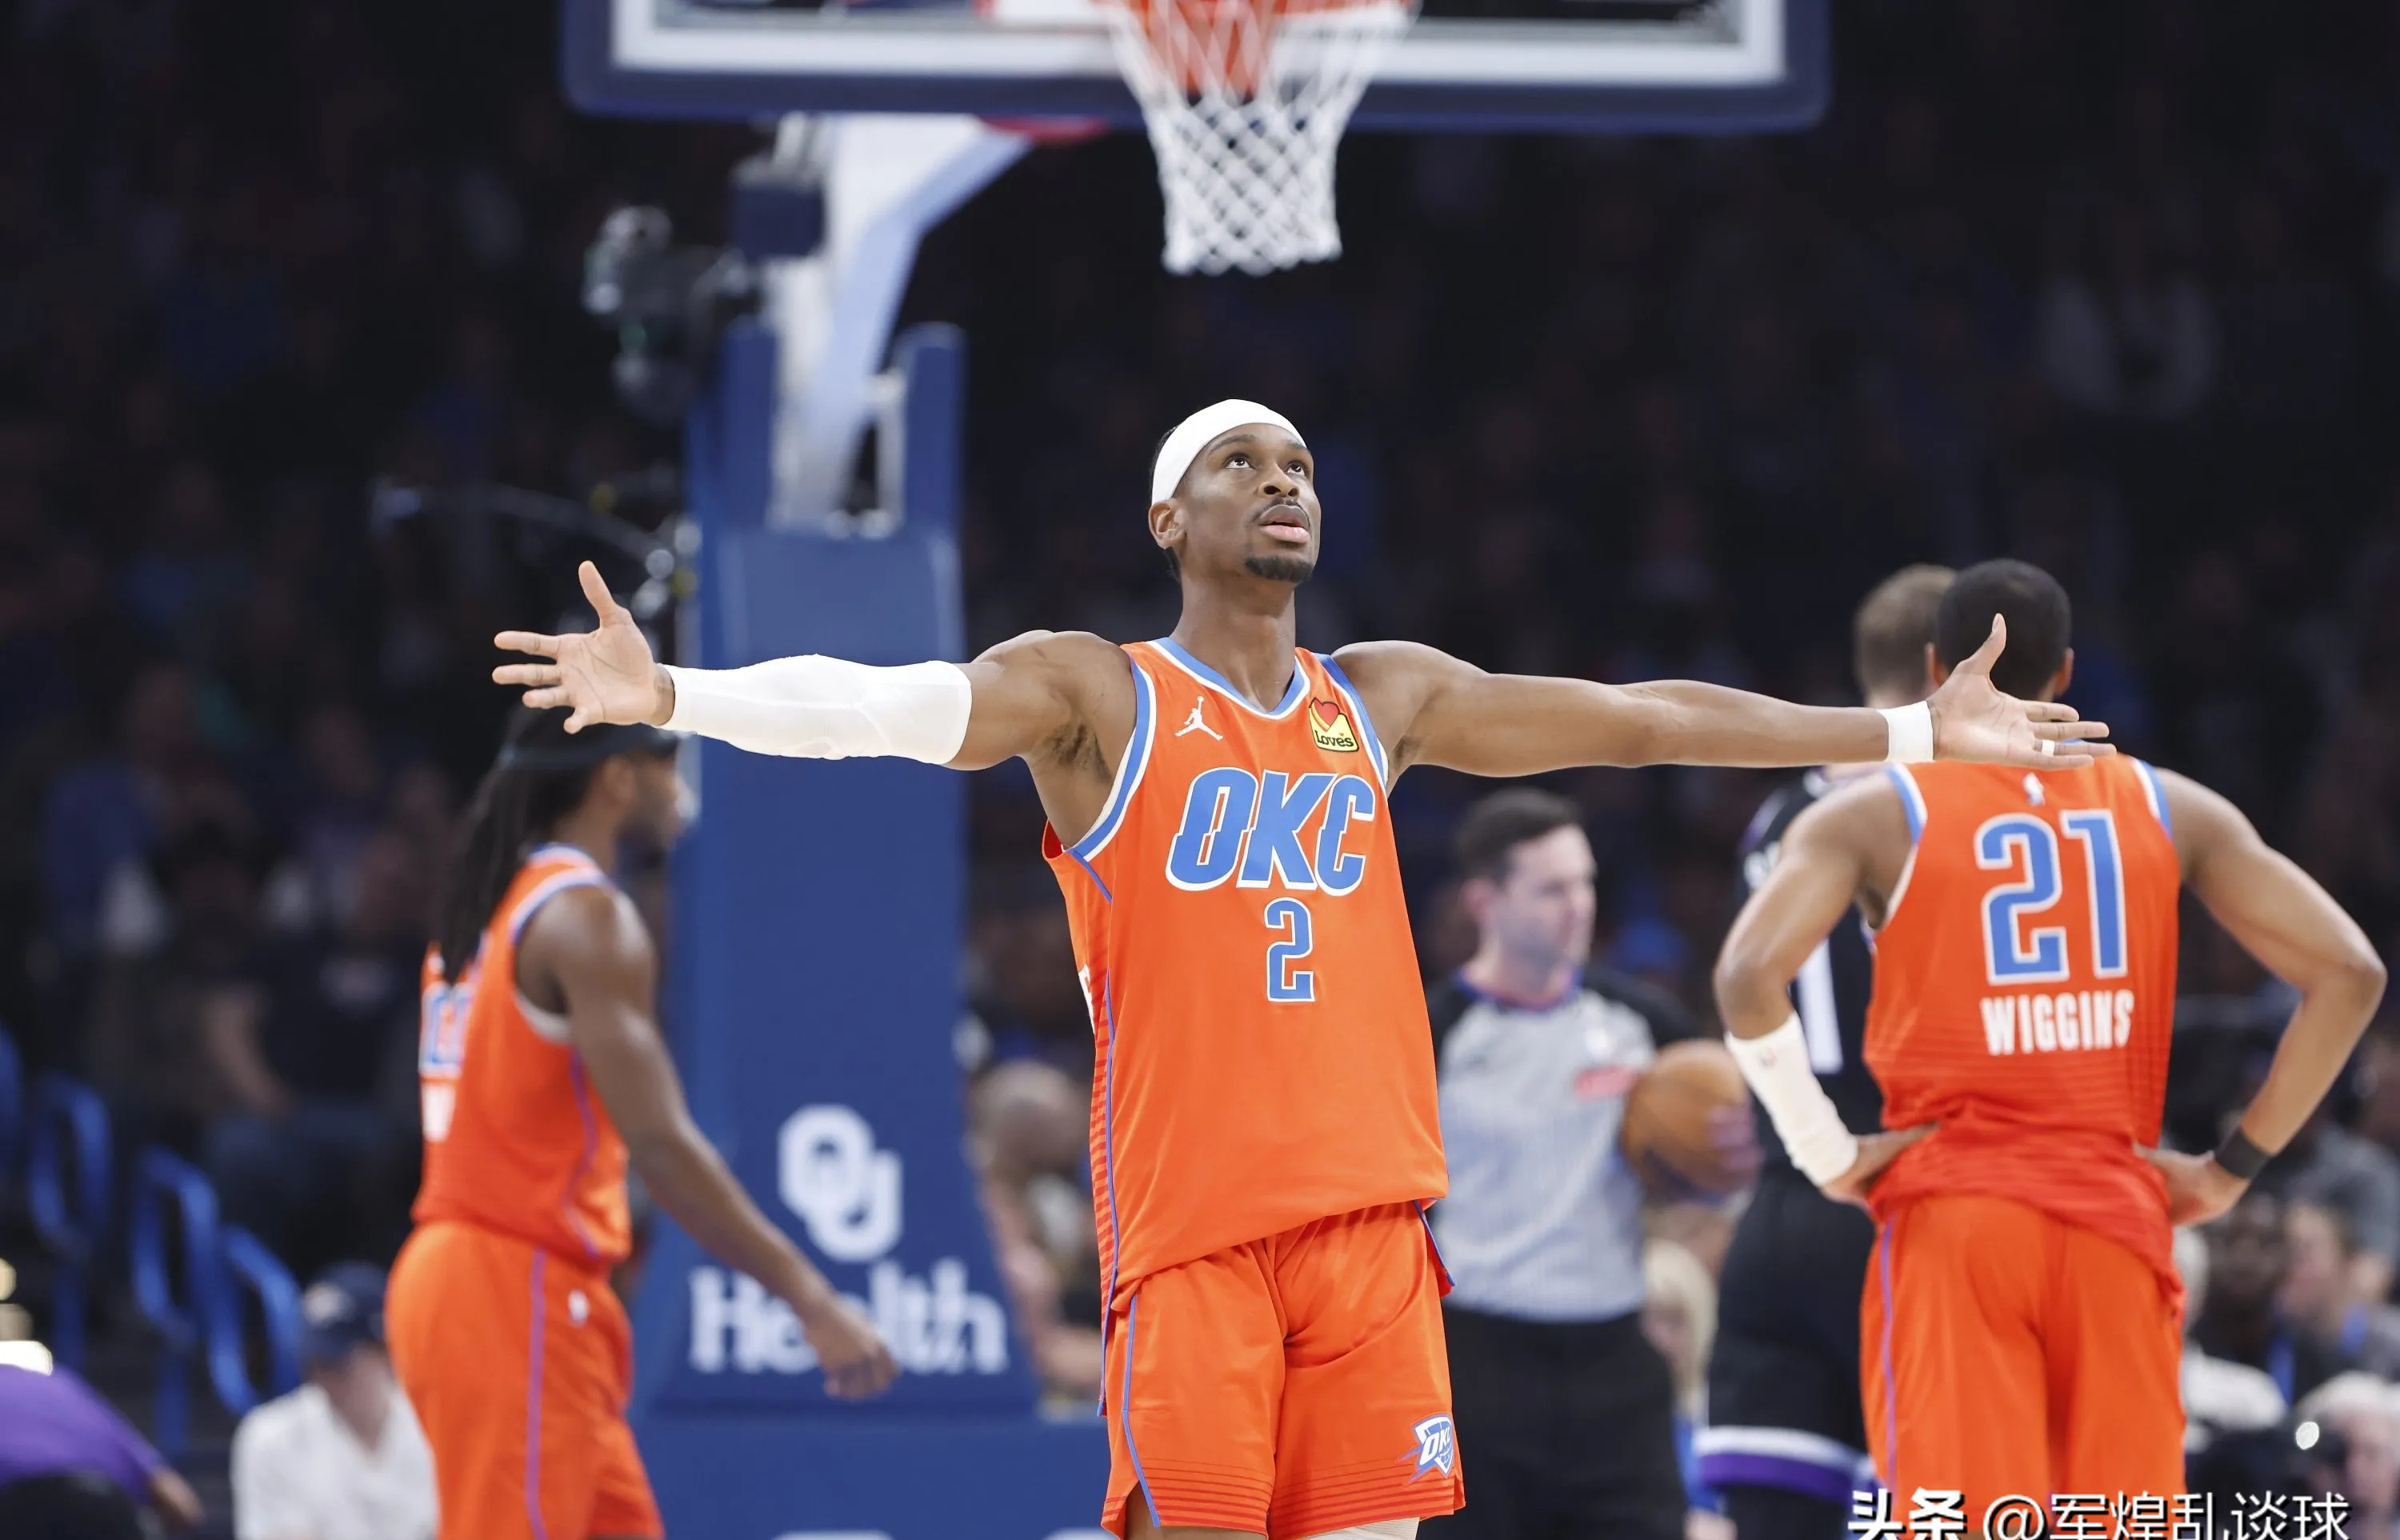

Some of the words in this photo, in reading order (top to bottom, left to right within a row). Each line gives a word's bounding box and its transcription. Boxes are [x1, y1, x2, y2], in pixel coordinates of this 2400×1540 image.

[1166, 766, 1375, 896] OKC
[1264, 897, 1315, 1002] 2
[1974, 808, 2128, 985] 21
[1980, 990, 2135, 1056] WIGGINS
[688, 1257, 1009, 1374] Helth
